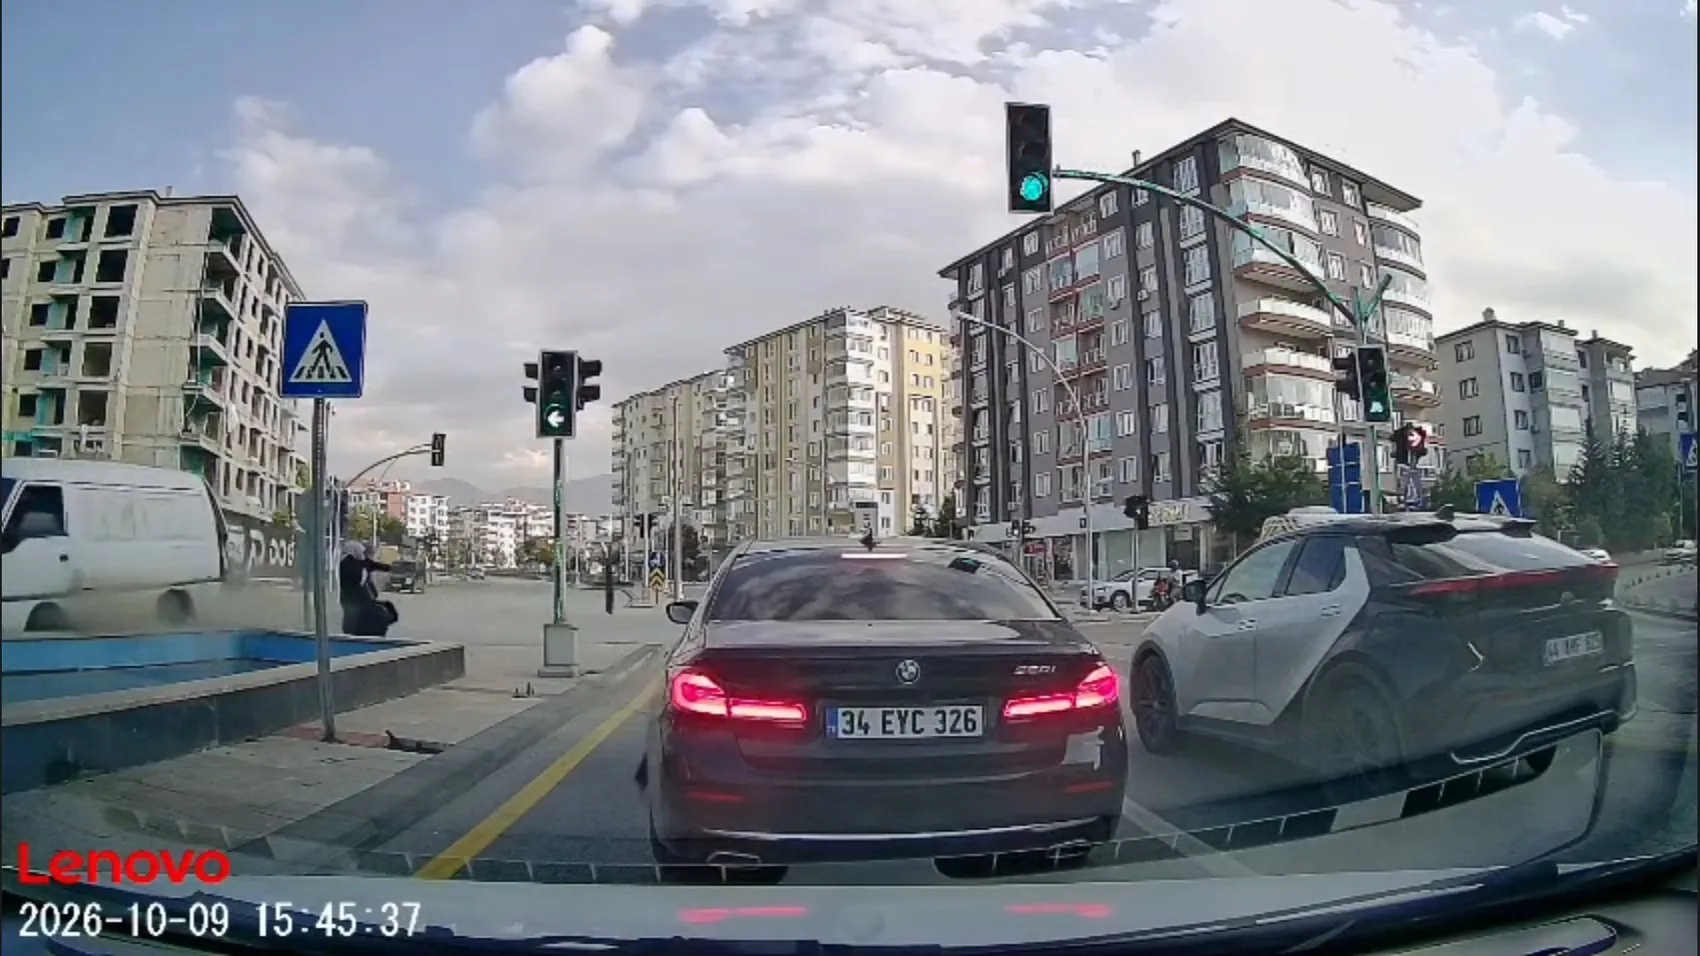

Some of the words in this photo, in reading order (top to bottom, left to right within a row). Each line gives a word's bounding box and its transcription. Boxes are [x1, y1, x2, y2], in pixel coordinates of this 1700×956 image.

[841, 709, 871, 735] 34
[881, 709, 925, 735] EYC
[934, 708, 977, 734] 326
